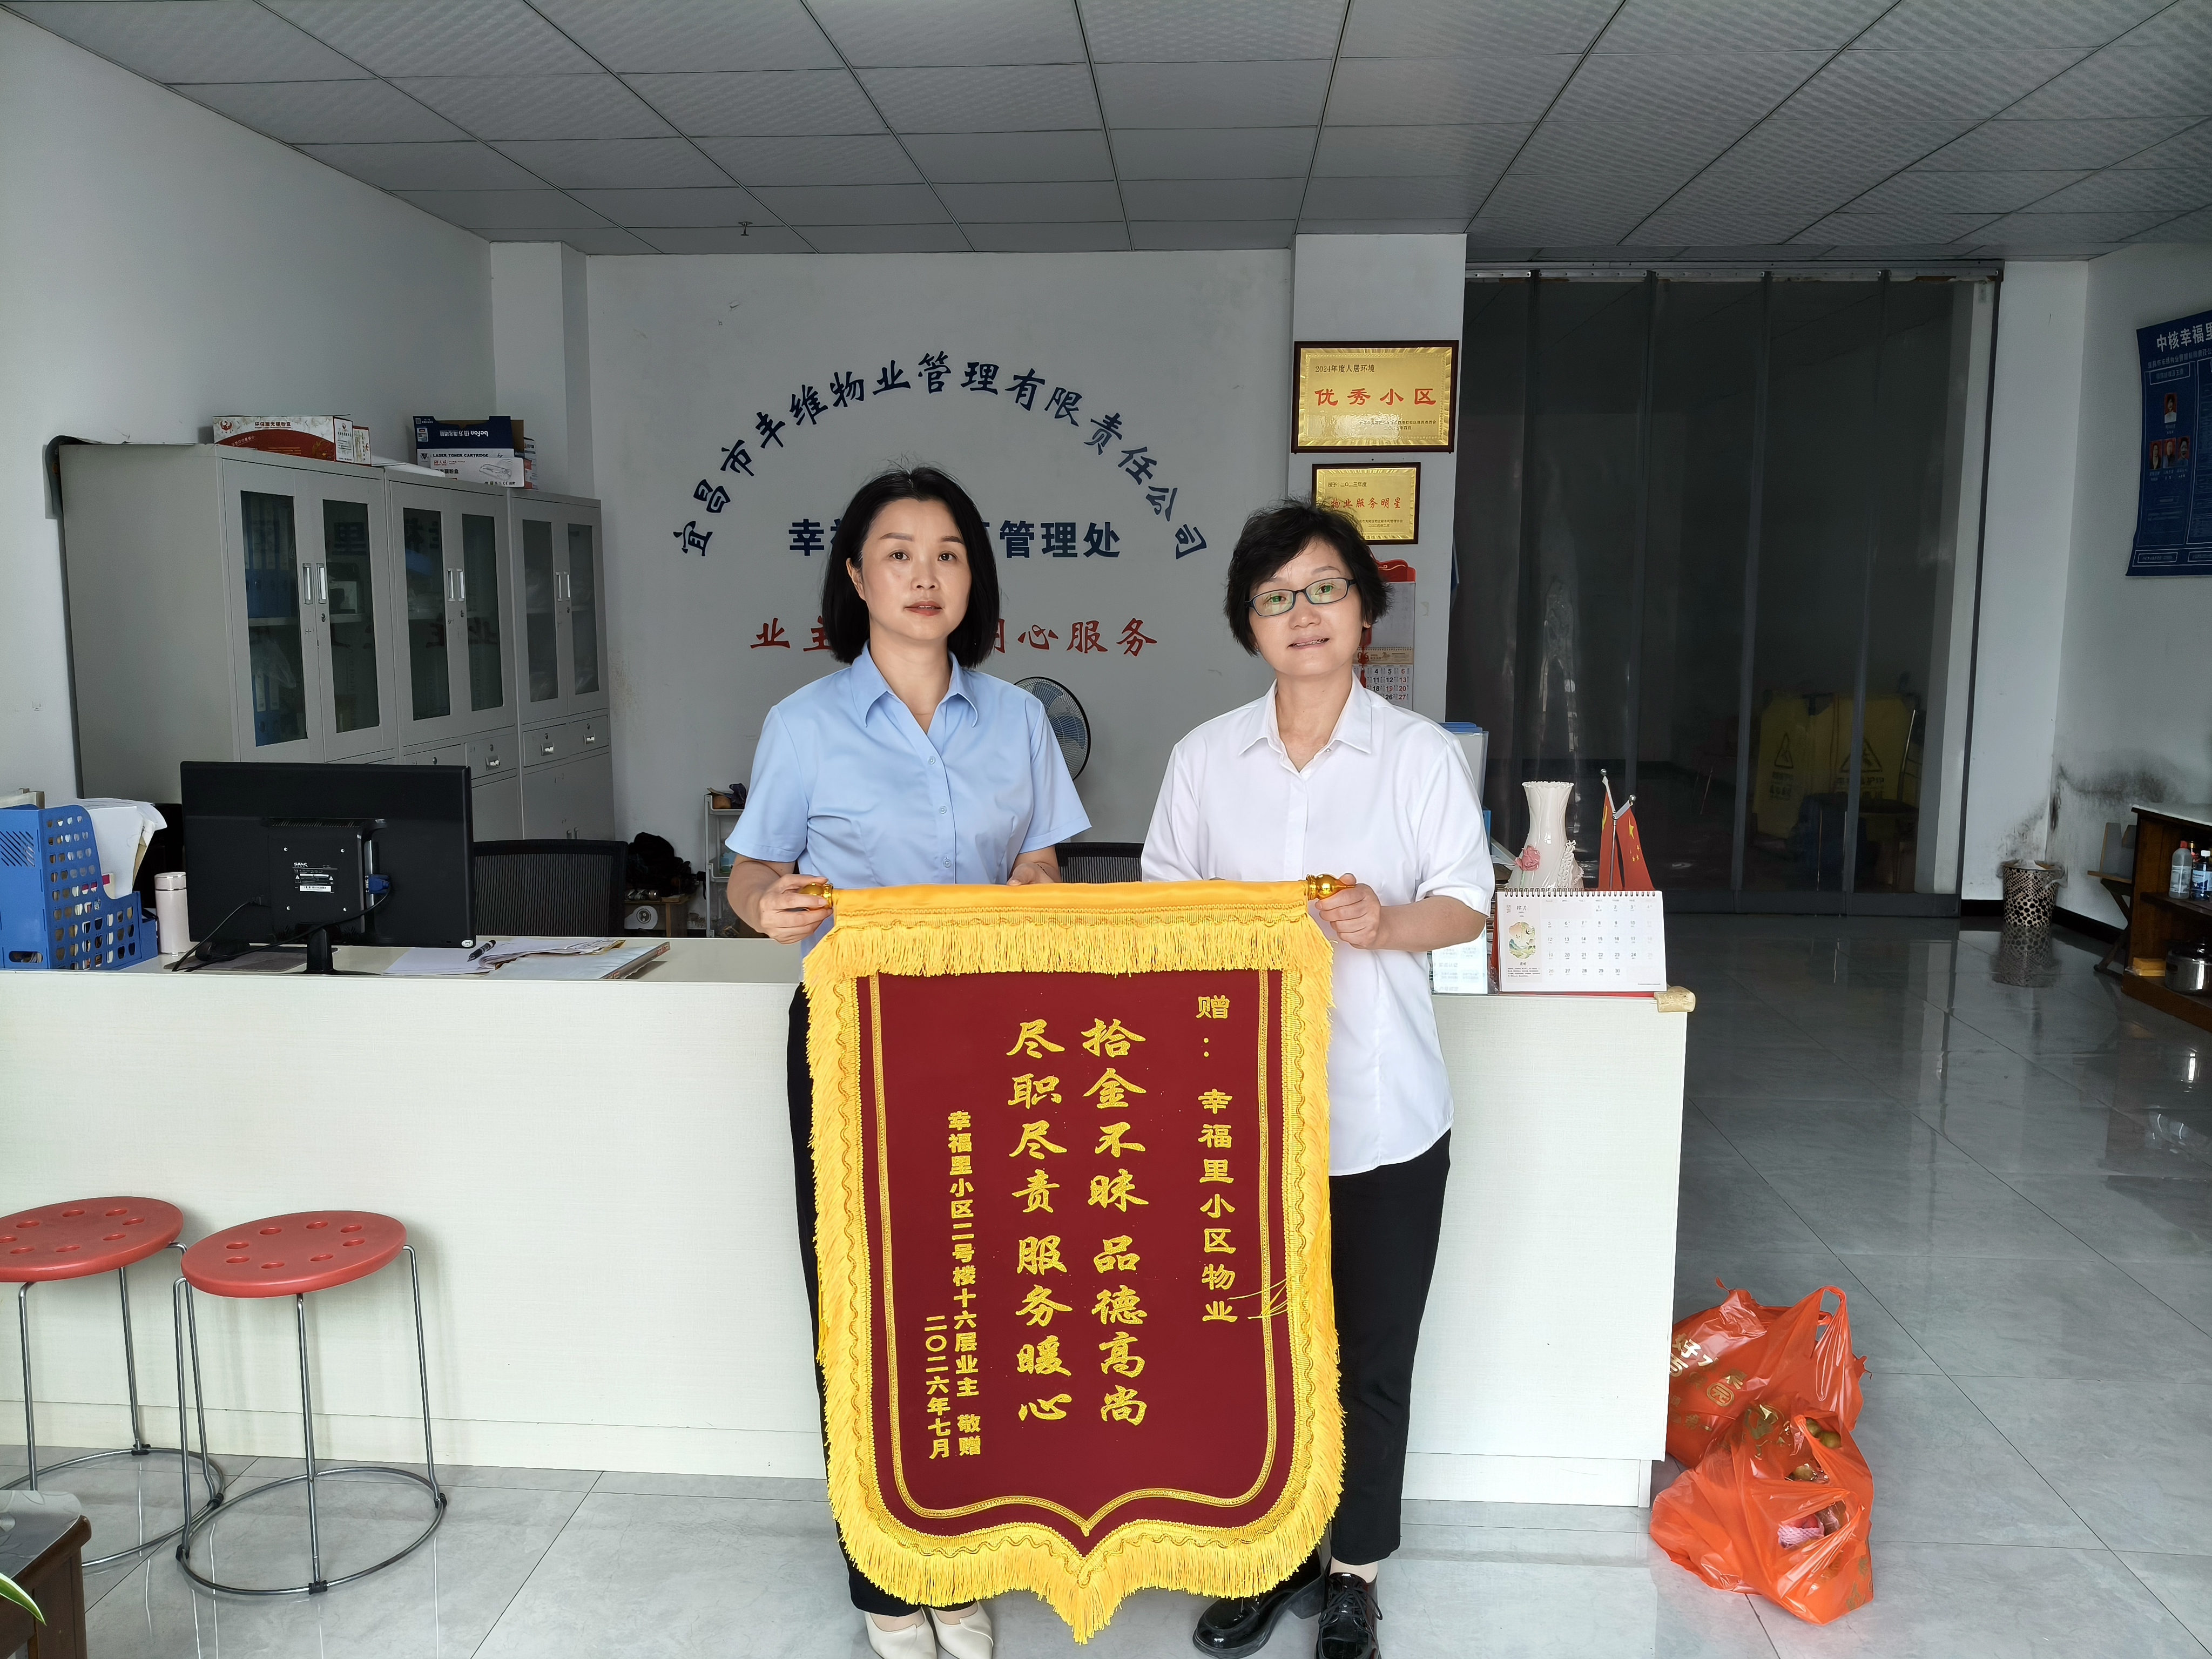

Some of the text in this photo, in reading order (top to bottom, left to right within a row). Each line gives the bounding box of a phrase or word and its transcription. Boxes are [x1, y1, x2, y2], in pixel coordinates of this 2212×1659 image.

[2156, 322, 2212, 352] 中核幸福里
[1315, 364, 1375, 373] 2024年度人居环境
[1314, 388, 1437, 406] 优秀小区
[673, 351, 1206, 559] 宜昌市丰维物业管理有限责任公司
[1330, 497, 1401, 509] 物业服务明星
[1197, 1088, 1238, 1323] 幸福里小区物业
[947, 1111, 981, 1456] 幸福里小区二号楼十六层业主 敬赠
